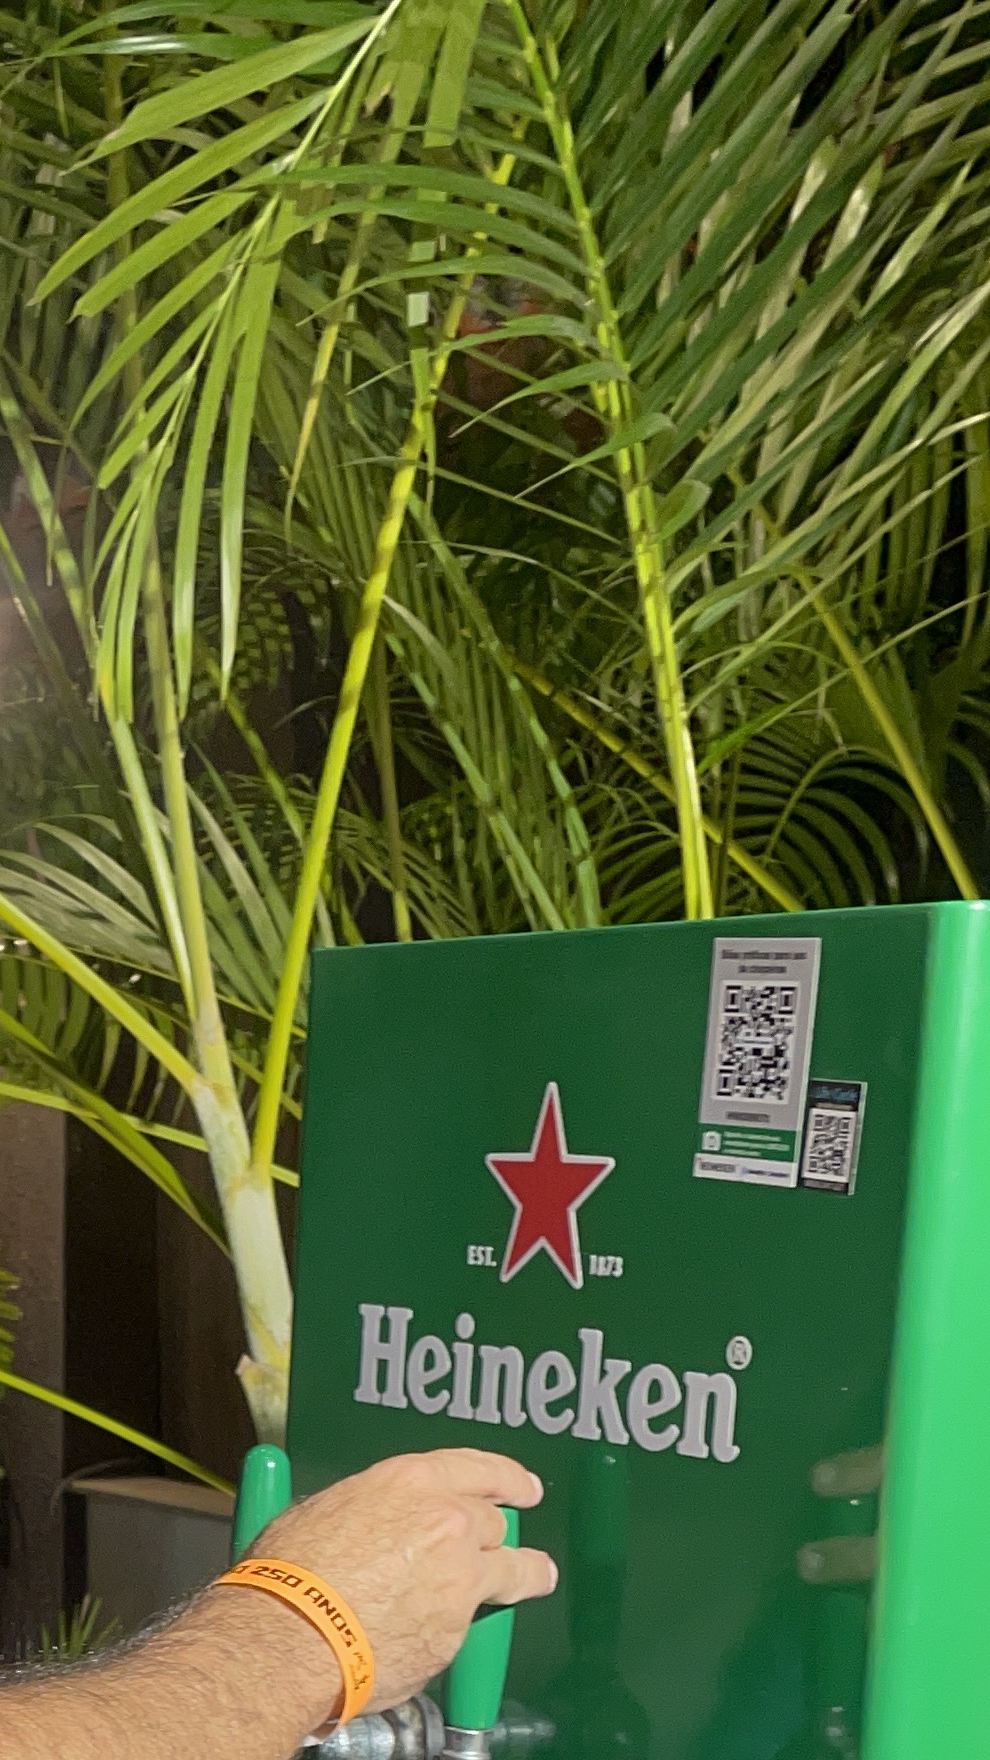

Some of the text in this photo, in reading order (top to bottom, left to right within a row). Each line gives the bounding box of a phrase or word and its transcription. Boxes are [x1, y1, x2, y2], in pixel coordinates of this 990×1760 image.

[467, 1245, 497, 1267] EST.
[250, 1565, 358, 1648] 250 ANOS
